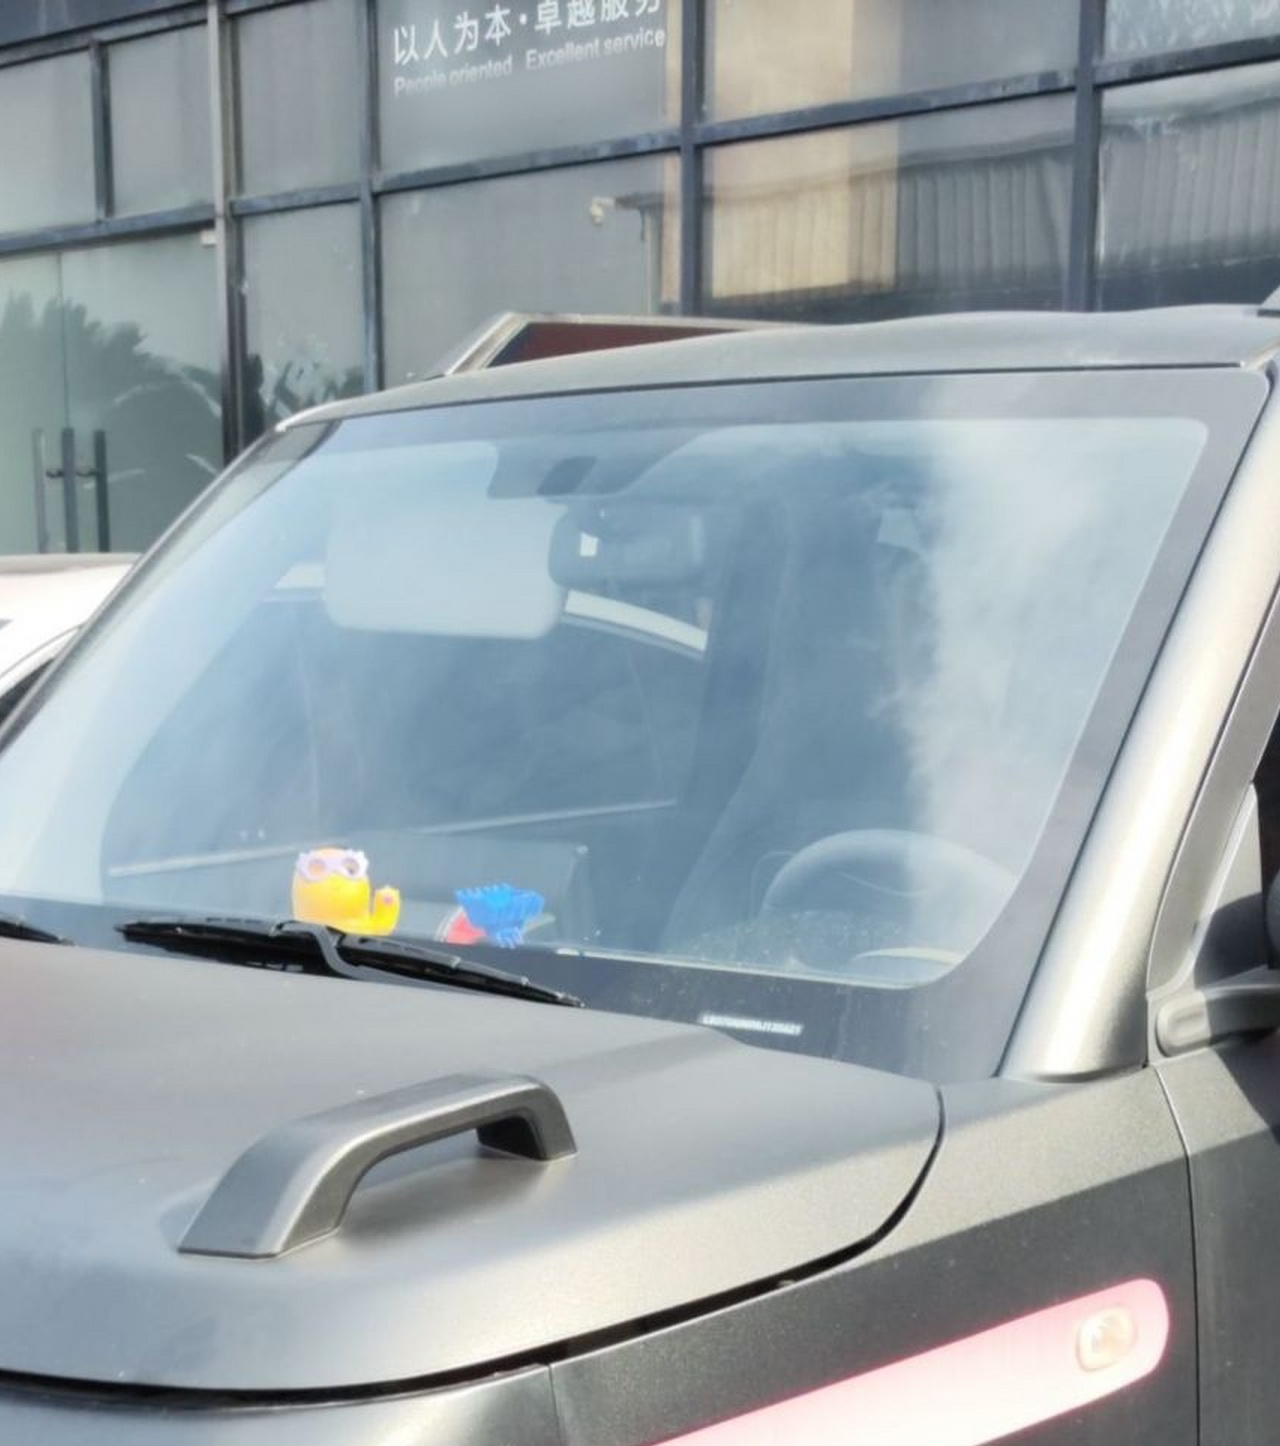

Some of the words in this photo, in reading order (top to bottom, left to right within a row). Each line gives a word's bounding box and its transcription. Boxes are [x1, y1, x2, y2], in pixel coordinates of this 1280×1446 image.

[394, 69, 447, 98] People
[449, 55, 513, 85] oriented
[525, 38, 600, 71] Excellent
[603, 27, 666, 56] service
